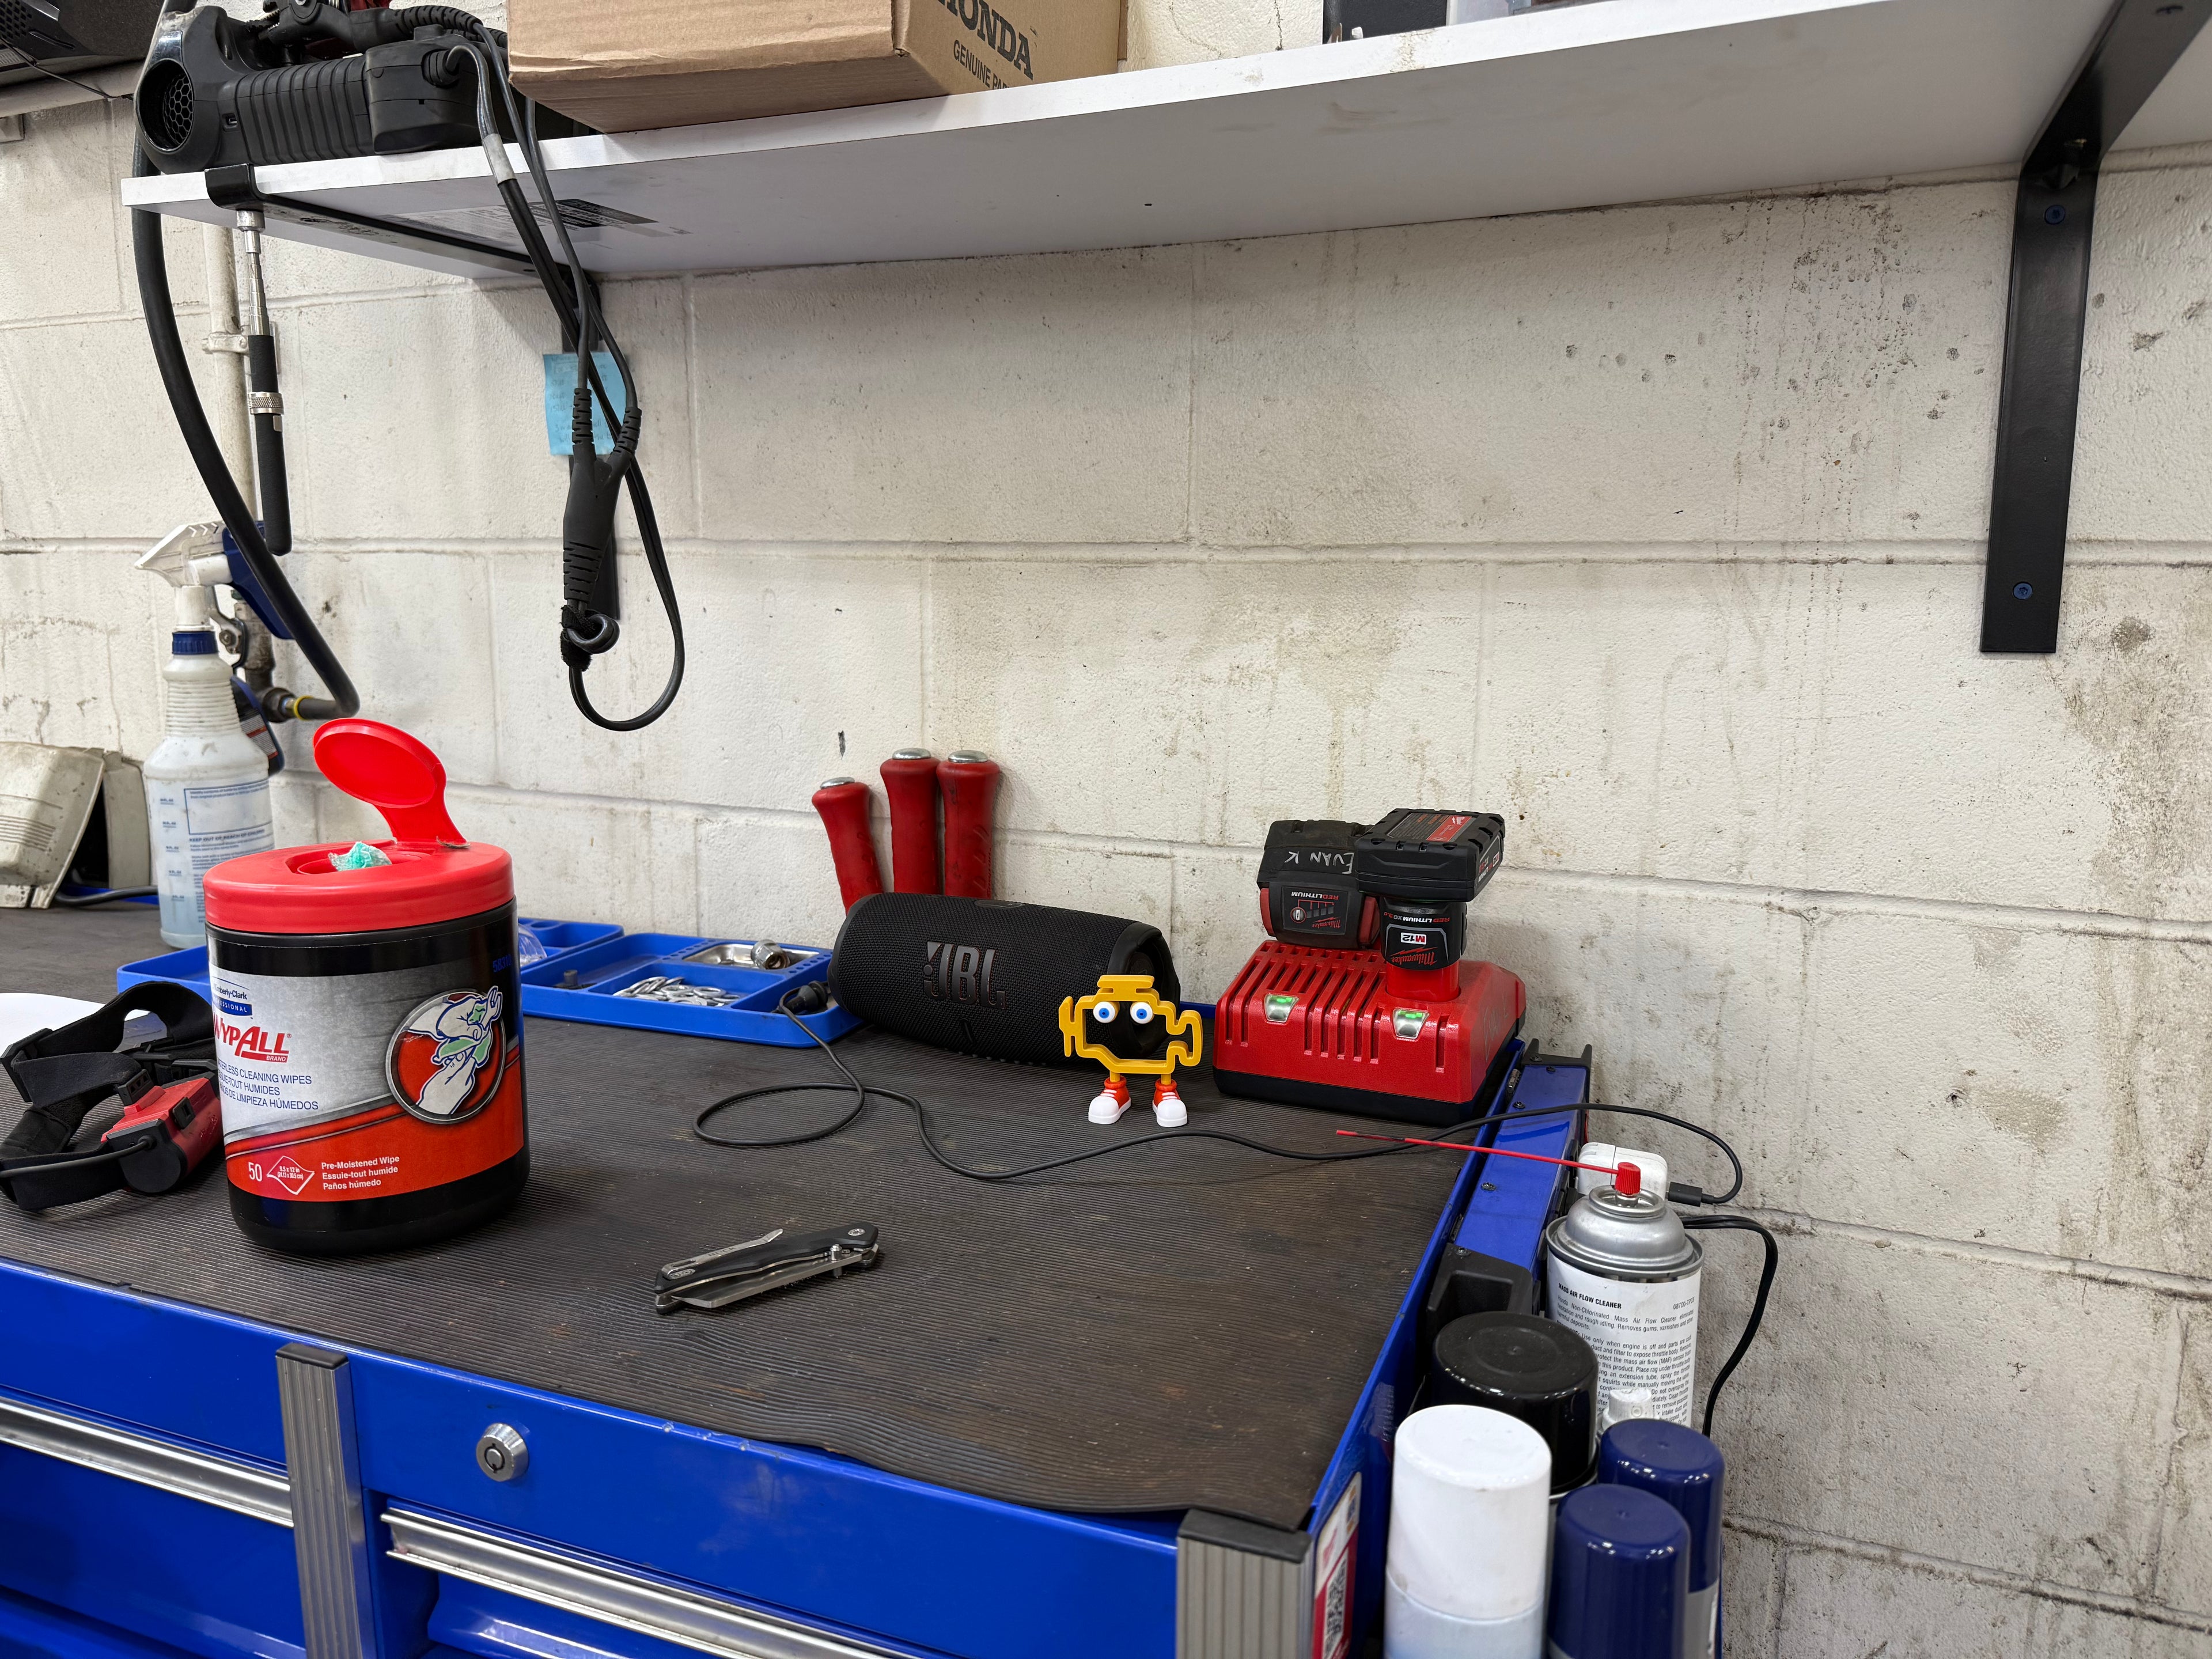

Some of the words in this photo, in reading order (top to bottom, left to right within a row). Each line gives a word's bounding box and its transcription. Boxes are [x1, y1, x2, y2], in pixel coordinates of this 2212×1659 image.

[953, 40, 991, 88] GENUINE
[1284, 851, 1300, 864] K
[1310, 851, 1354, 874] EVAN
[1402, 934, 1426, 943] M12
[1391, 952, 1438, 966] Milwaukee
[923, 941, 1005, 1008] JBL
[214, 983, 247, 1000] mberly-Clark
[214, 997, 247, 1013] FESSIONAL
[218, 1058, 238, 1076] TERLESS
[240, 1069, 279, 1083] CLEANING
[281, 1074, 312, 1084] WIPES
[244, 1082, 280, 1096] HUMIDES
[229, 1089, 236, 1099] DE
[237, 1092, 268, 1107] LIMPIEZA
[270, 1097, 319, 1110] HÚMEDOS
[321, 1158, 378, 1170] Pre-Moistened
[379, 1156, 400, 1165] Wipe
[248, 1162, 262, 1181] 50
[322, 1170, 365, 1180] Essuie-tout
[366, 1166, 398, 1175] humide
[323, 1181, 347, 1190] Paños
[349, 1179, 381, 1188] húmedo
[1558, 1282, 1569, 1293] MASS
[1570, 1289, 1578, 1298] AIR
[1579, 1293, 1594, 1303] FLOW
[1595, 1298, 1622, 1309] CLEANER
[1571, 1302, 1609, 1319] Non-Chlorinated
[1570, 1318, 1590, 1330] deposits.
[1585, 1317, 1599, 1325] rough
[1600, 1321, 1615, 1329] idling.
[1618, 1324, 1642, 1332] Removes
[1660, 1323, 1679, 1331] varnishes
[1613, 1364, 1634, 1372] product.
[1659, 1357, 1672, 1365] (MAF)
[1603, 1378, 1620, 1386] squirts
